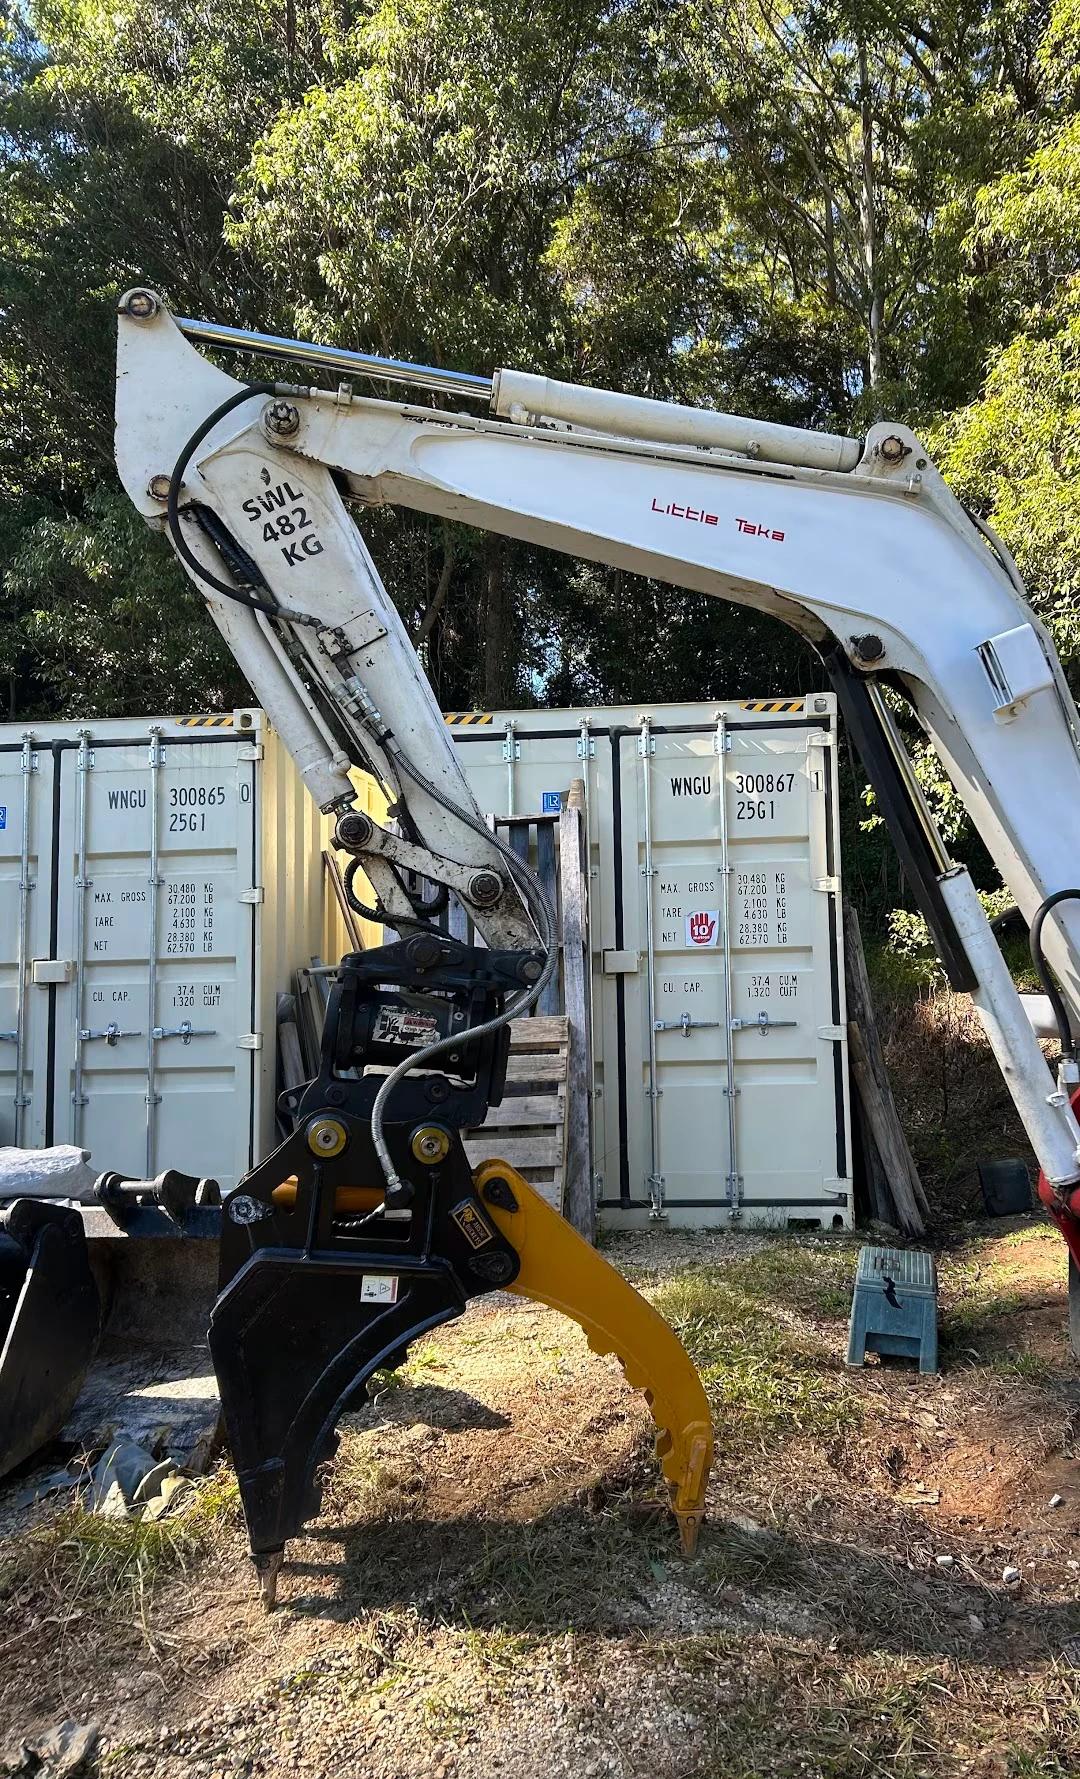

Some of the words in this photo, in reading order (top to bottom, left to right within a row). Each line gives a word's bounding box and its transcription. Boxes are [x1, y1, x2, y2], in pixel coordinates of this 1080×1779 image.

[242, 482, 304, 522] SWL
[263, 507, 313, 542] 482
[651, 498, 719, 526] Little
[735, 518, 785, 542] Taka
[281, 533, 324, 567] KG
[671, 775, 711, 797] WNGU
[736, 773, 795, 793] 300867
[108, 789, 146, 810] WNGU
[169, 786, 225, 806] 300865
[737, 800, 774, 820] 25G1
[169, 813, 205, 832] 25G1
[738, 874, 767, 885] 30.480
[775, 873, 786, 883] KG
[168, 883, 196, 894] 30.480
[204, 883, 214, 893] KG
[660, 883, 681, 894] MAX.
[688, 882, 715, 893] GROSS
[738, 885, 767, 895] 67.200
[776, 884, 786, 894] LB
[94, 892, 114, 903] MAX.
[120, 891, 146, 902] GROSS
[168, 894, 196, 904] 67.200
[204, 894, 214, 904] LB
[744, 898, 767, 909] 2.100
[776, 898, 786, 908] KG
[173, 908, 196, 918] 2.100
[204, 907, 214, 917] KG
[662, 907, 682, 918] TARE
[744, 910, 768, 920] 4.630
[776, 909, 787, 919] LB
[95, 916, 114, 927] TARE
[172, 919, 196, 929] 4.630
[203, 918, 213, 928] LB
[692, 924, 709, 936] 10
[739, 923, 768, 934] 28.380
[777, 922, 788, 933] KG
[167, 932, 195, 942] 28.380
[203, 931, 213, 941] KG
[662, 932, 677, 942] NET
[739, 934, 769, 944] 62.570
[777, 933, 788, 944] LB
[93, 940, 108, 951] NET
[167, 942, 195, 953] 62.570
[203, 942, 213, 952] LB
[752, 976, 770, 986] 37.4
[177, 985, 195, 996] 37.4
[663, 982, 676, 993] CU.
[684, 982, 704, 993] CAP.
[748, 987, 770, 998] 1.320
[92, 991, 105, 1002] CU.
[173, 996, 195, 1007] 1.320
